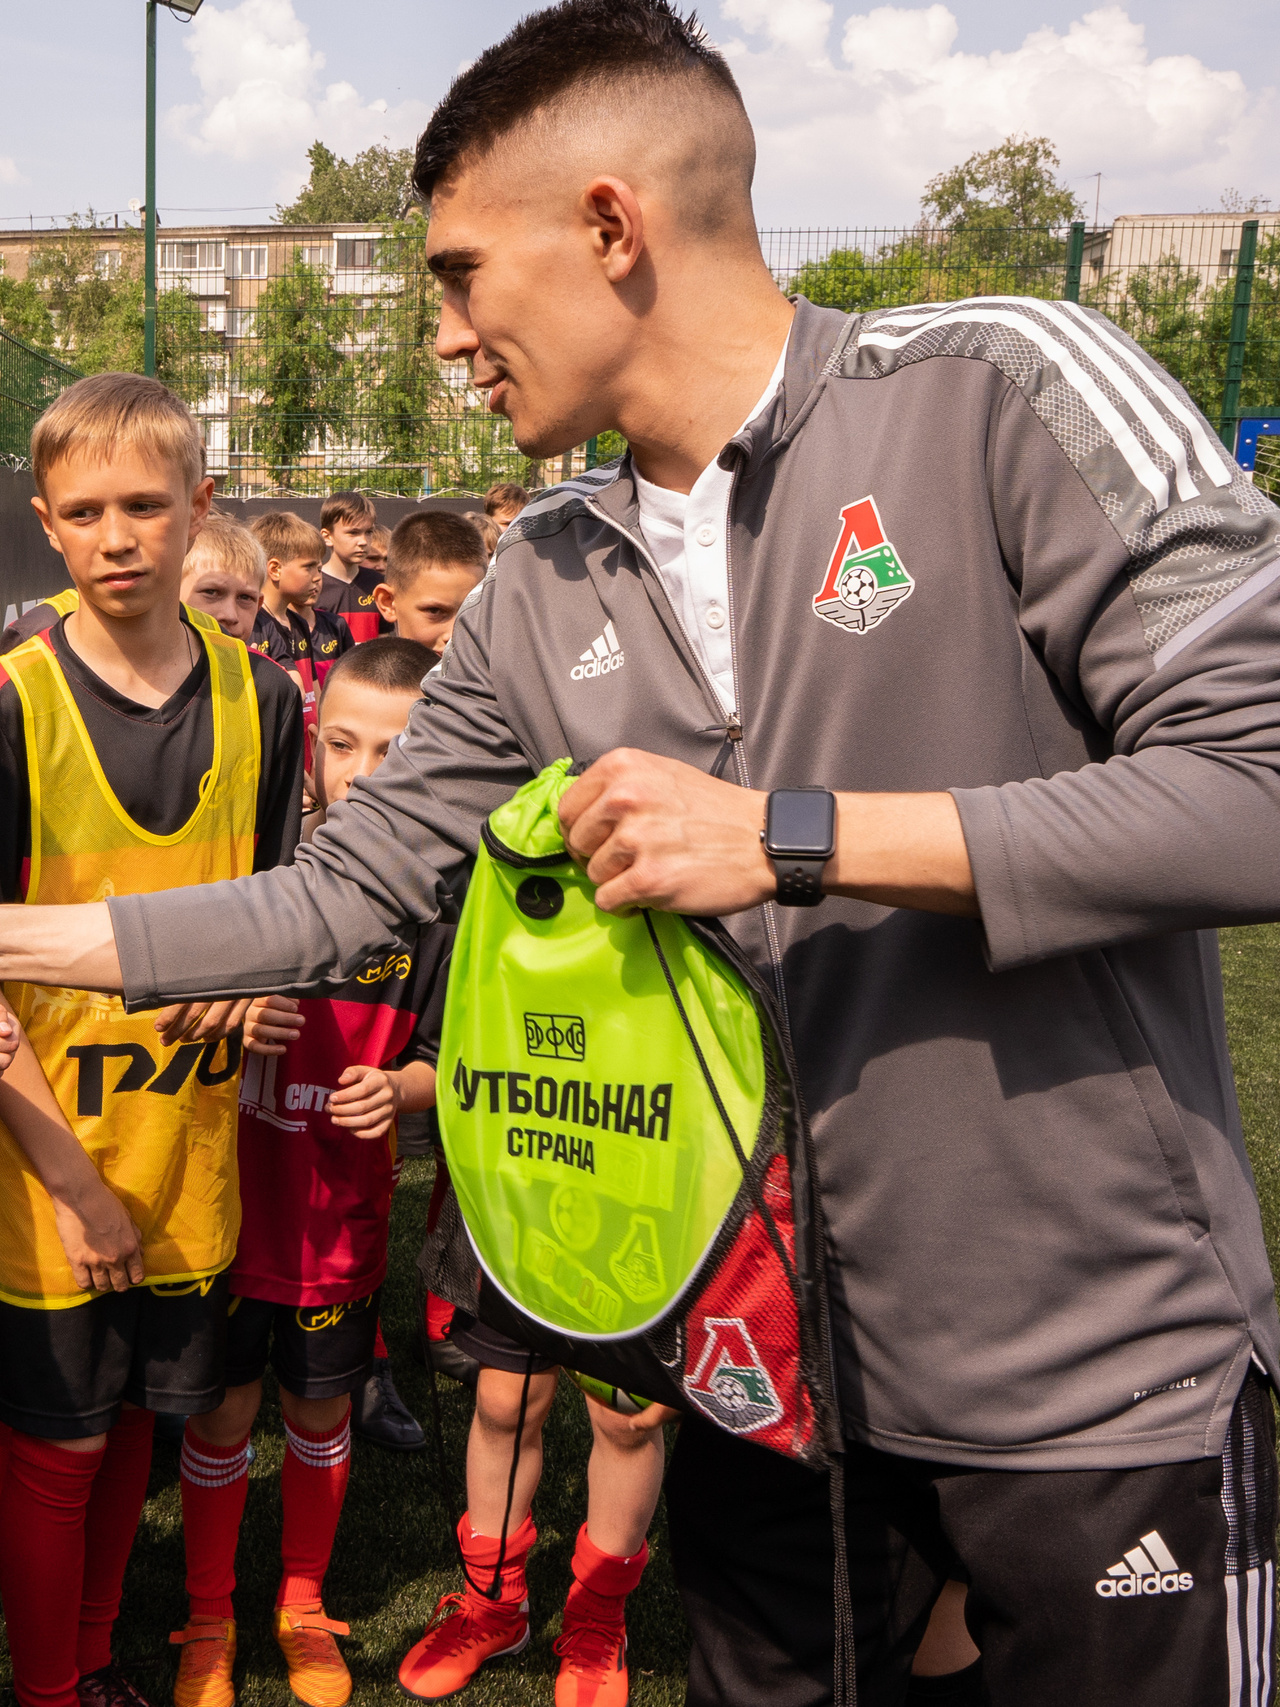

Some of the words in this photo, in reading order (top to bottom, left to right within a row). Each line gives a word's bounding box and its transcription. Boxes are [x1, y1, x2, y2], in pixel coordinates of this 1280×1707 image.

[569, 650, 625, 681] adidas
[284, 1082, 338, 1113] СИТ
[506, 1125, 597, 1176] СТРАНА
[1133, 1376, 1197, 1401] PRIMEBLUE
[1095, 1570, 1195, 1598] adidas
